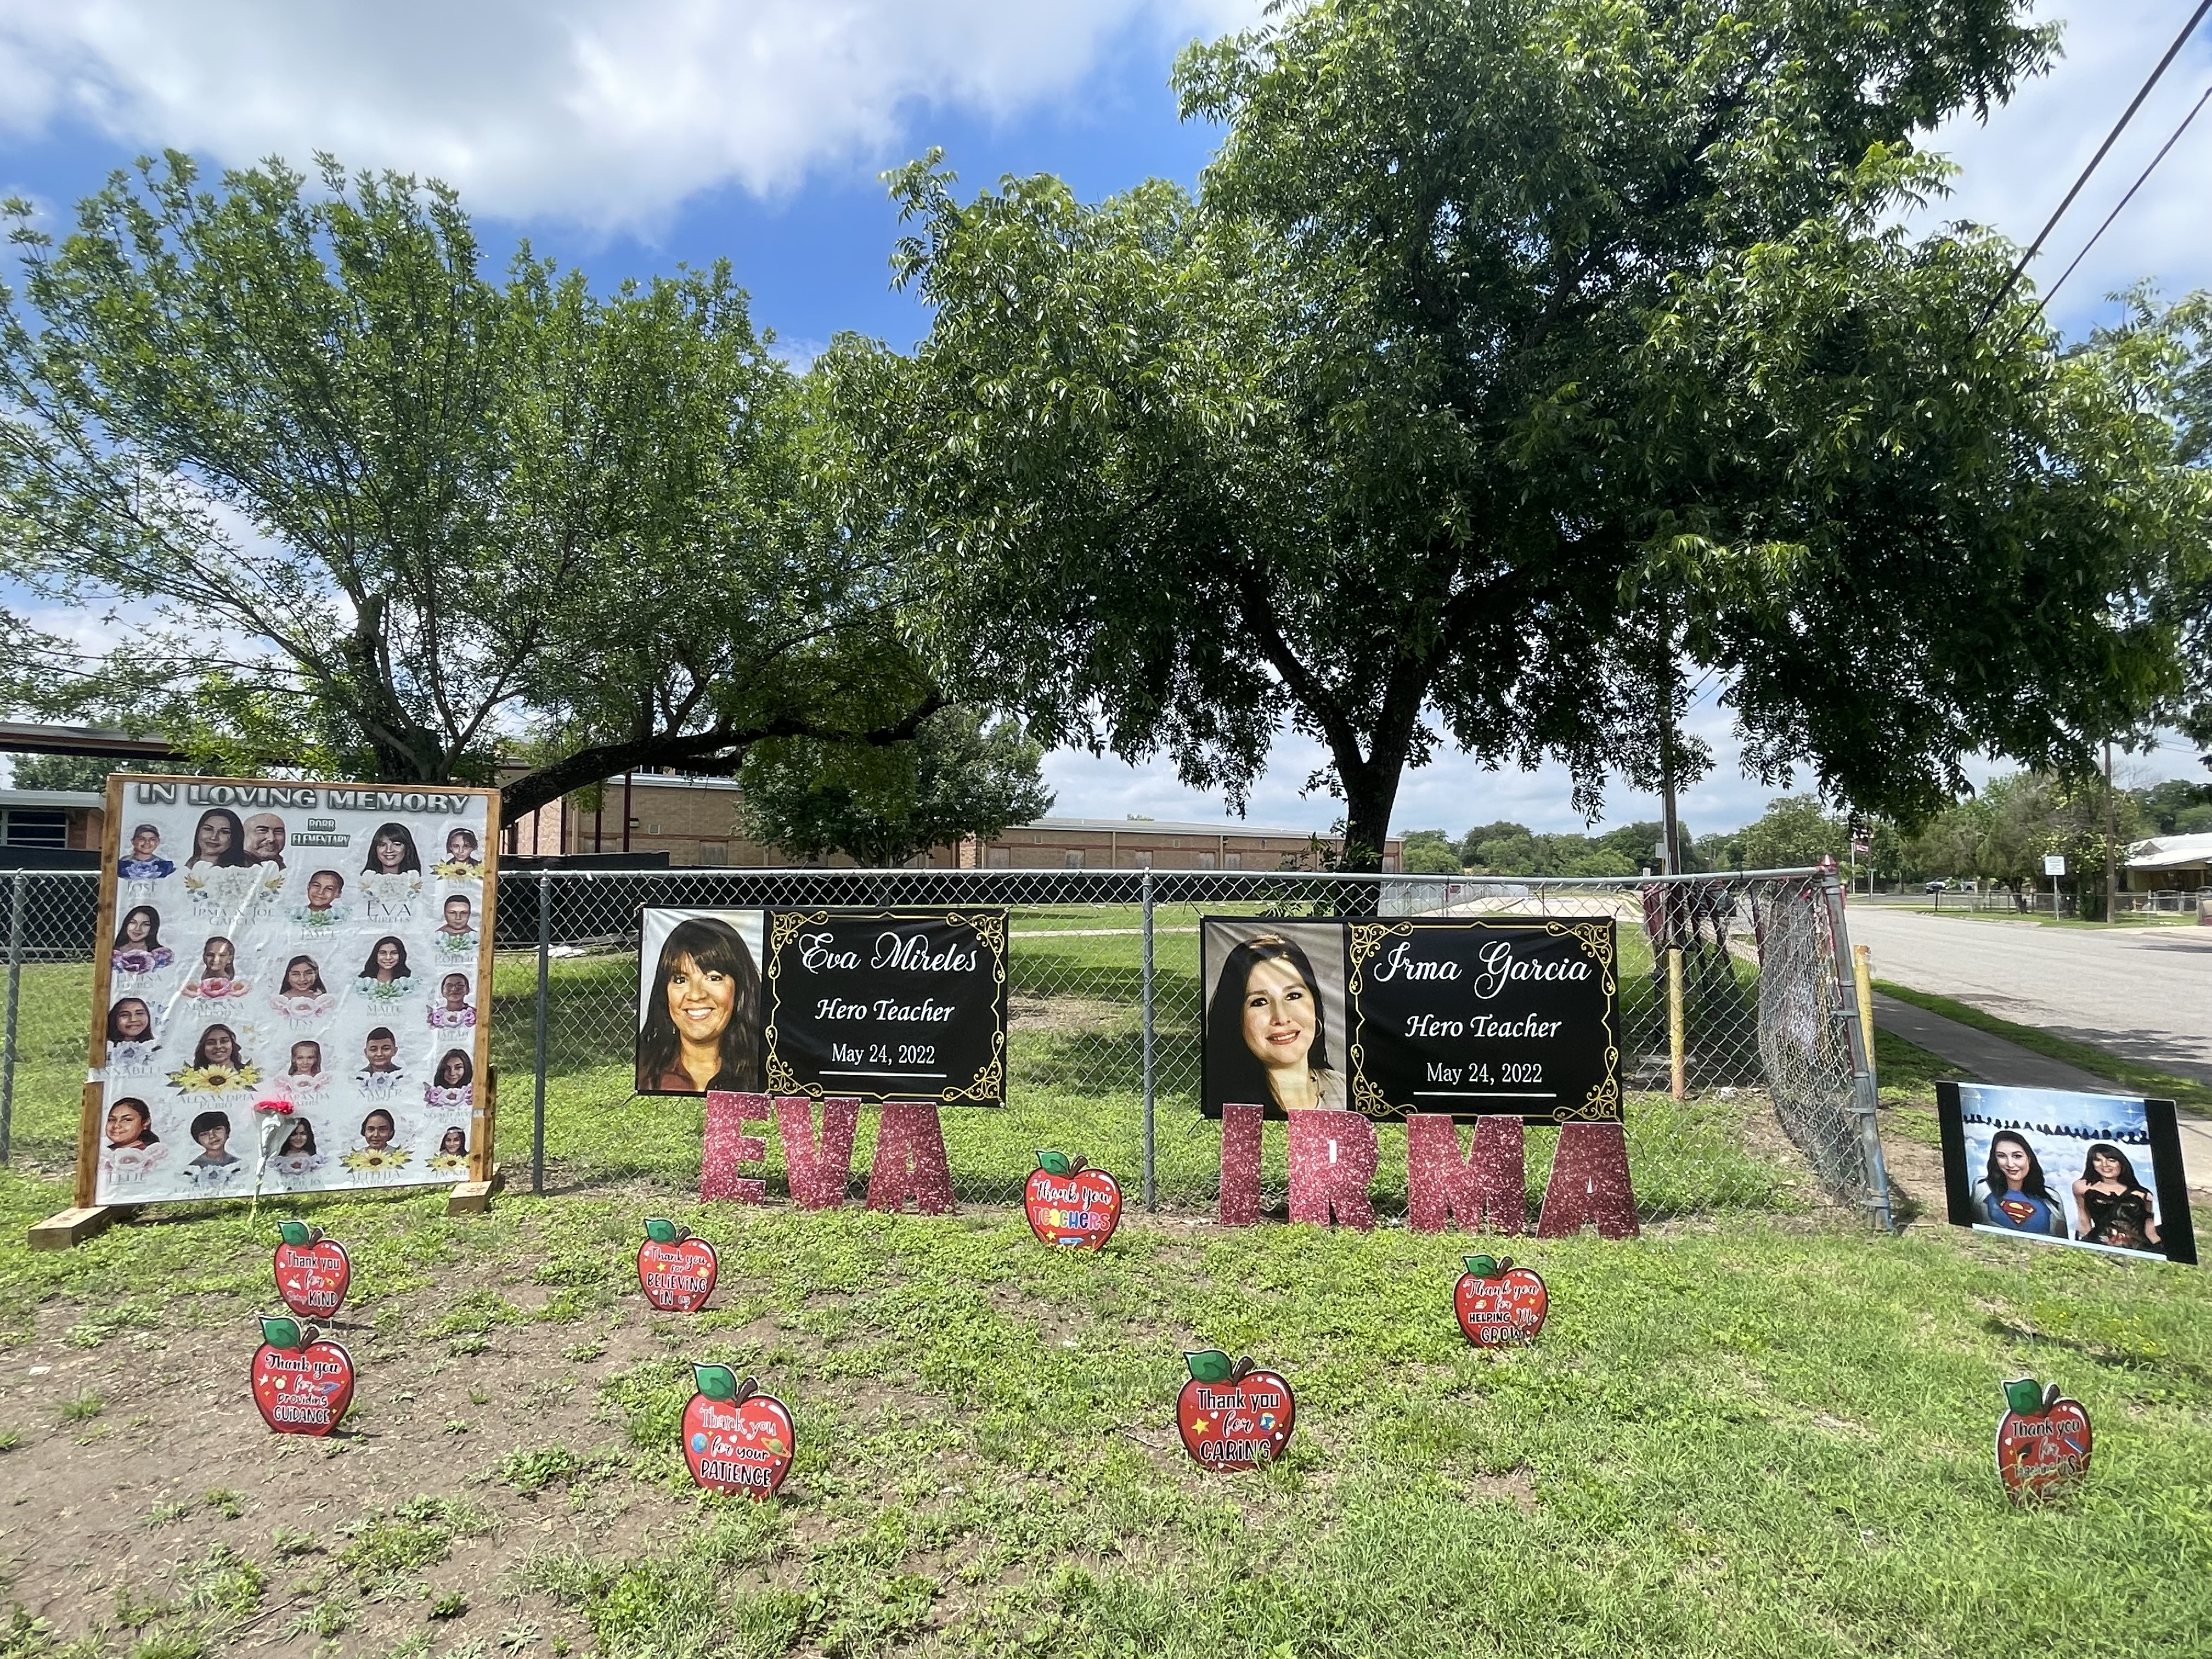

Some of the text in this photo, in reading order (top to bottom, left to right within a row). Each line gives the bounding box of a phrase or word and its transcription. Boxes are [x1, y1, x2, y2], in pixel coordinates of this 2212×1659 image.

[137, 783, 468, 814] IN LOVING MEMORY
[367, 899, 411, 916] EVA
[799, 932, 979, 974] Eva Mireles
[1374, 940, 1593, 1000] Irma Garcia
[814, 998, 956, 1022] Hero Teacher
[1404, 1013, 1562, 1039] Hero Teacher
[832, 1043, 935, 1065] May 24, 2022
[1426, 1062, 1543, 1085] May 24, 2022
[699, 1090, 956, 1216] EVA
[1219, 1103, 1640, 1241] IRMA
[1031, 1179, 1079, 1203] Thank
[286, 1248, 340, 1273] Thank you
[648, 1245, 708, 1271] Thank you
[304, 1269, 325, 1290] for
[1463, 1279, 1540, 1301] Thank you
[1494, 1295, 1513, 1312] for
[1468, 1311, 1512, 1323] HELPING
[264, 1352, 342, 1379] Thank you
[1196, 1387, 1280, 1414] Thank you
[699, 1406, 777, 1441] Thank you
[1222, 1410, 1255, 1438] for
[2012, 1417, 2080, 1440] Thank you
[711, 1435, 770, 1460] for your
[2039, 1436, 2059, 1461] for
